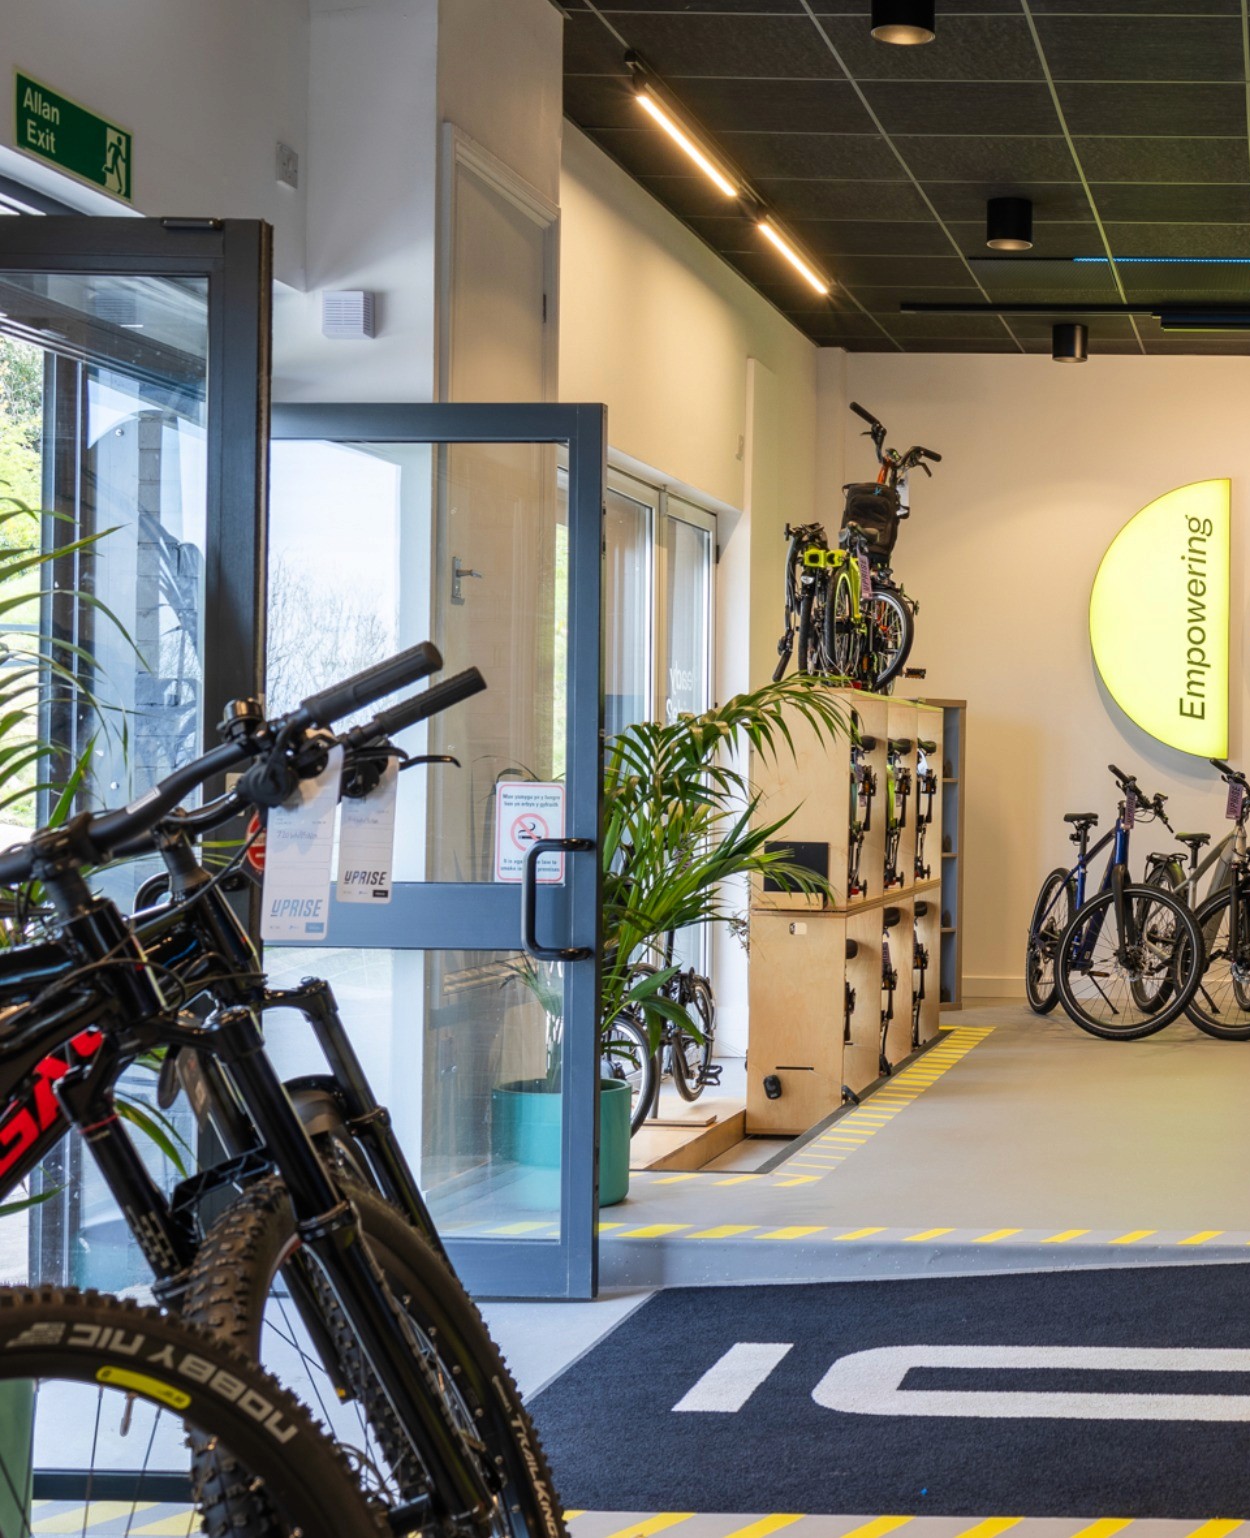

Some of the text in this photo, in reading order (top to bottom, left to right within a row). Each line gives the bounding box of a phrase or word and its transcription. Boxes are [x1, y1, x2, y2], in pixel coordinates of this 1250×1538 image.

[23, 86, 60, 125] Allan
[26, 118, 56, 154] Exit
[1179, 514, 1213, 720] Empowering
[344, 870, 387, 885] UPRISE
[270, 899, 323, 917] UPRISE
[67, 1323, 299, 1444] NOBBY NIC
